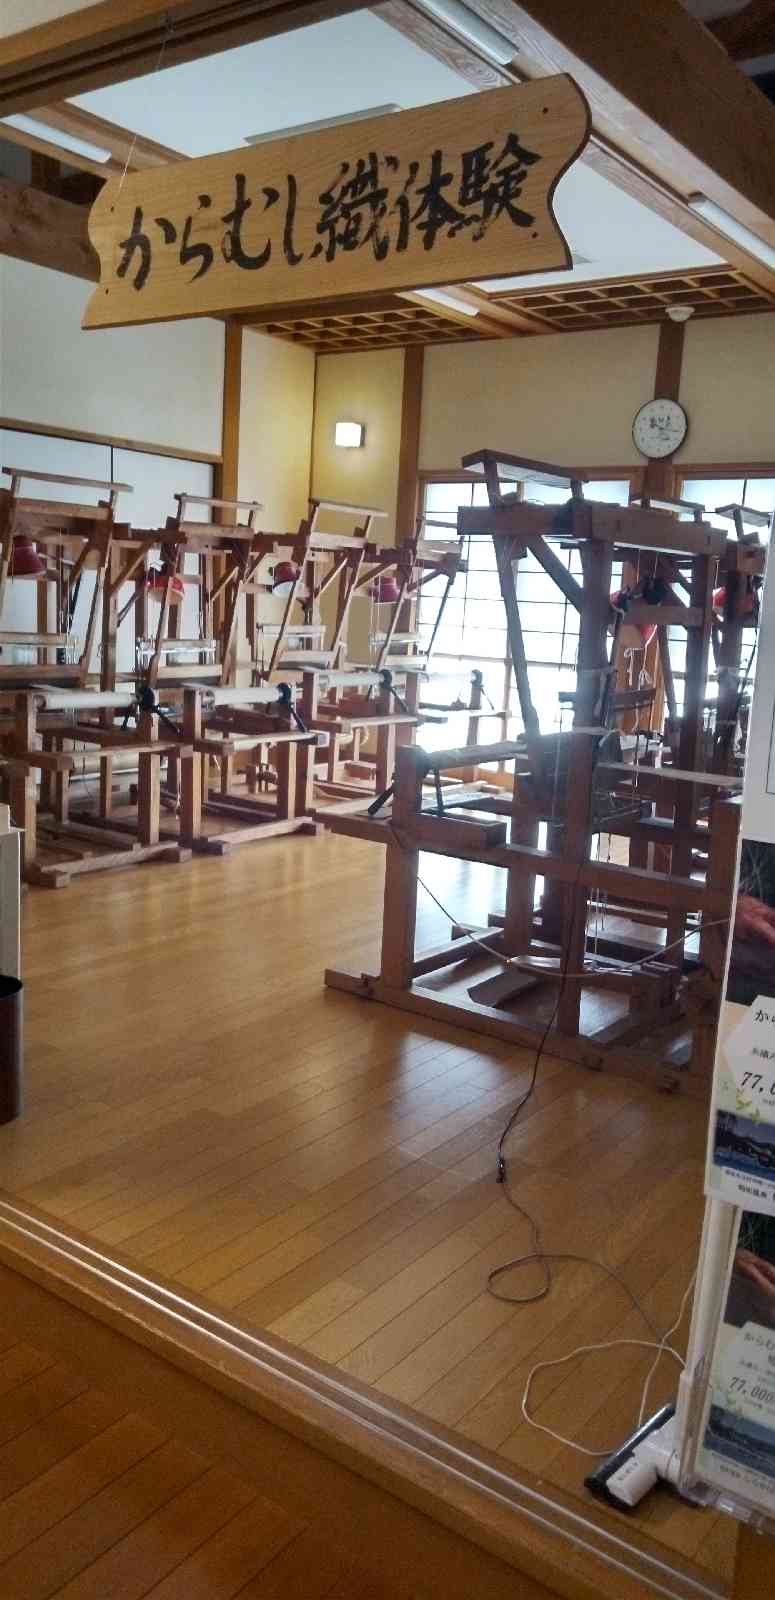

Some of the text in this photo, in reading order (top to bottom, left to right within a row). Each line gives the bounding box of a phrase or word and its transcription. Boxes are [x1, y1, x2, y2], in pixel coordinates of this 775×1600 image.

[116, 132, 542, 291] からむし織体験
